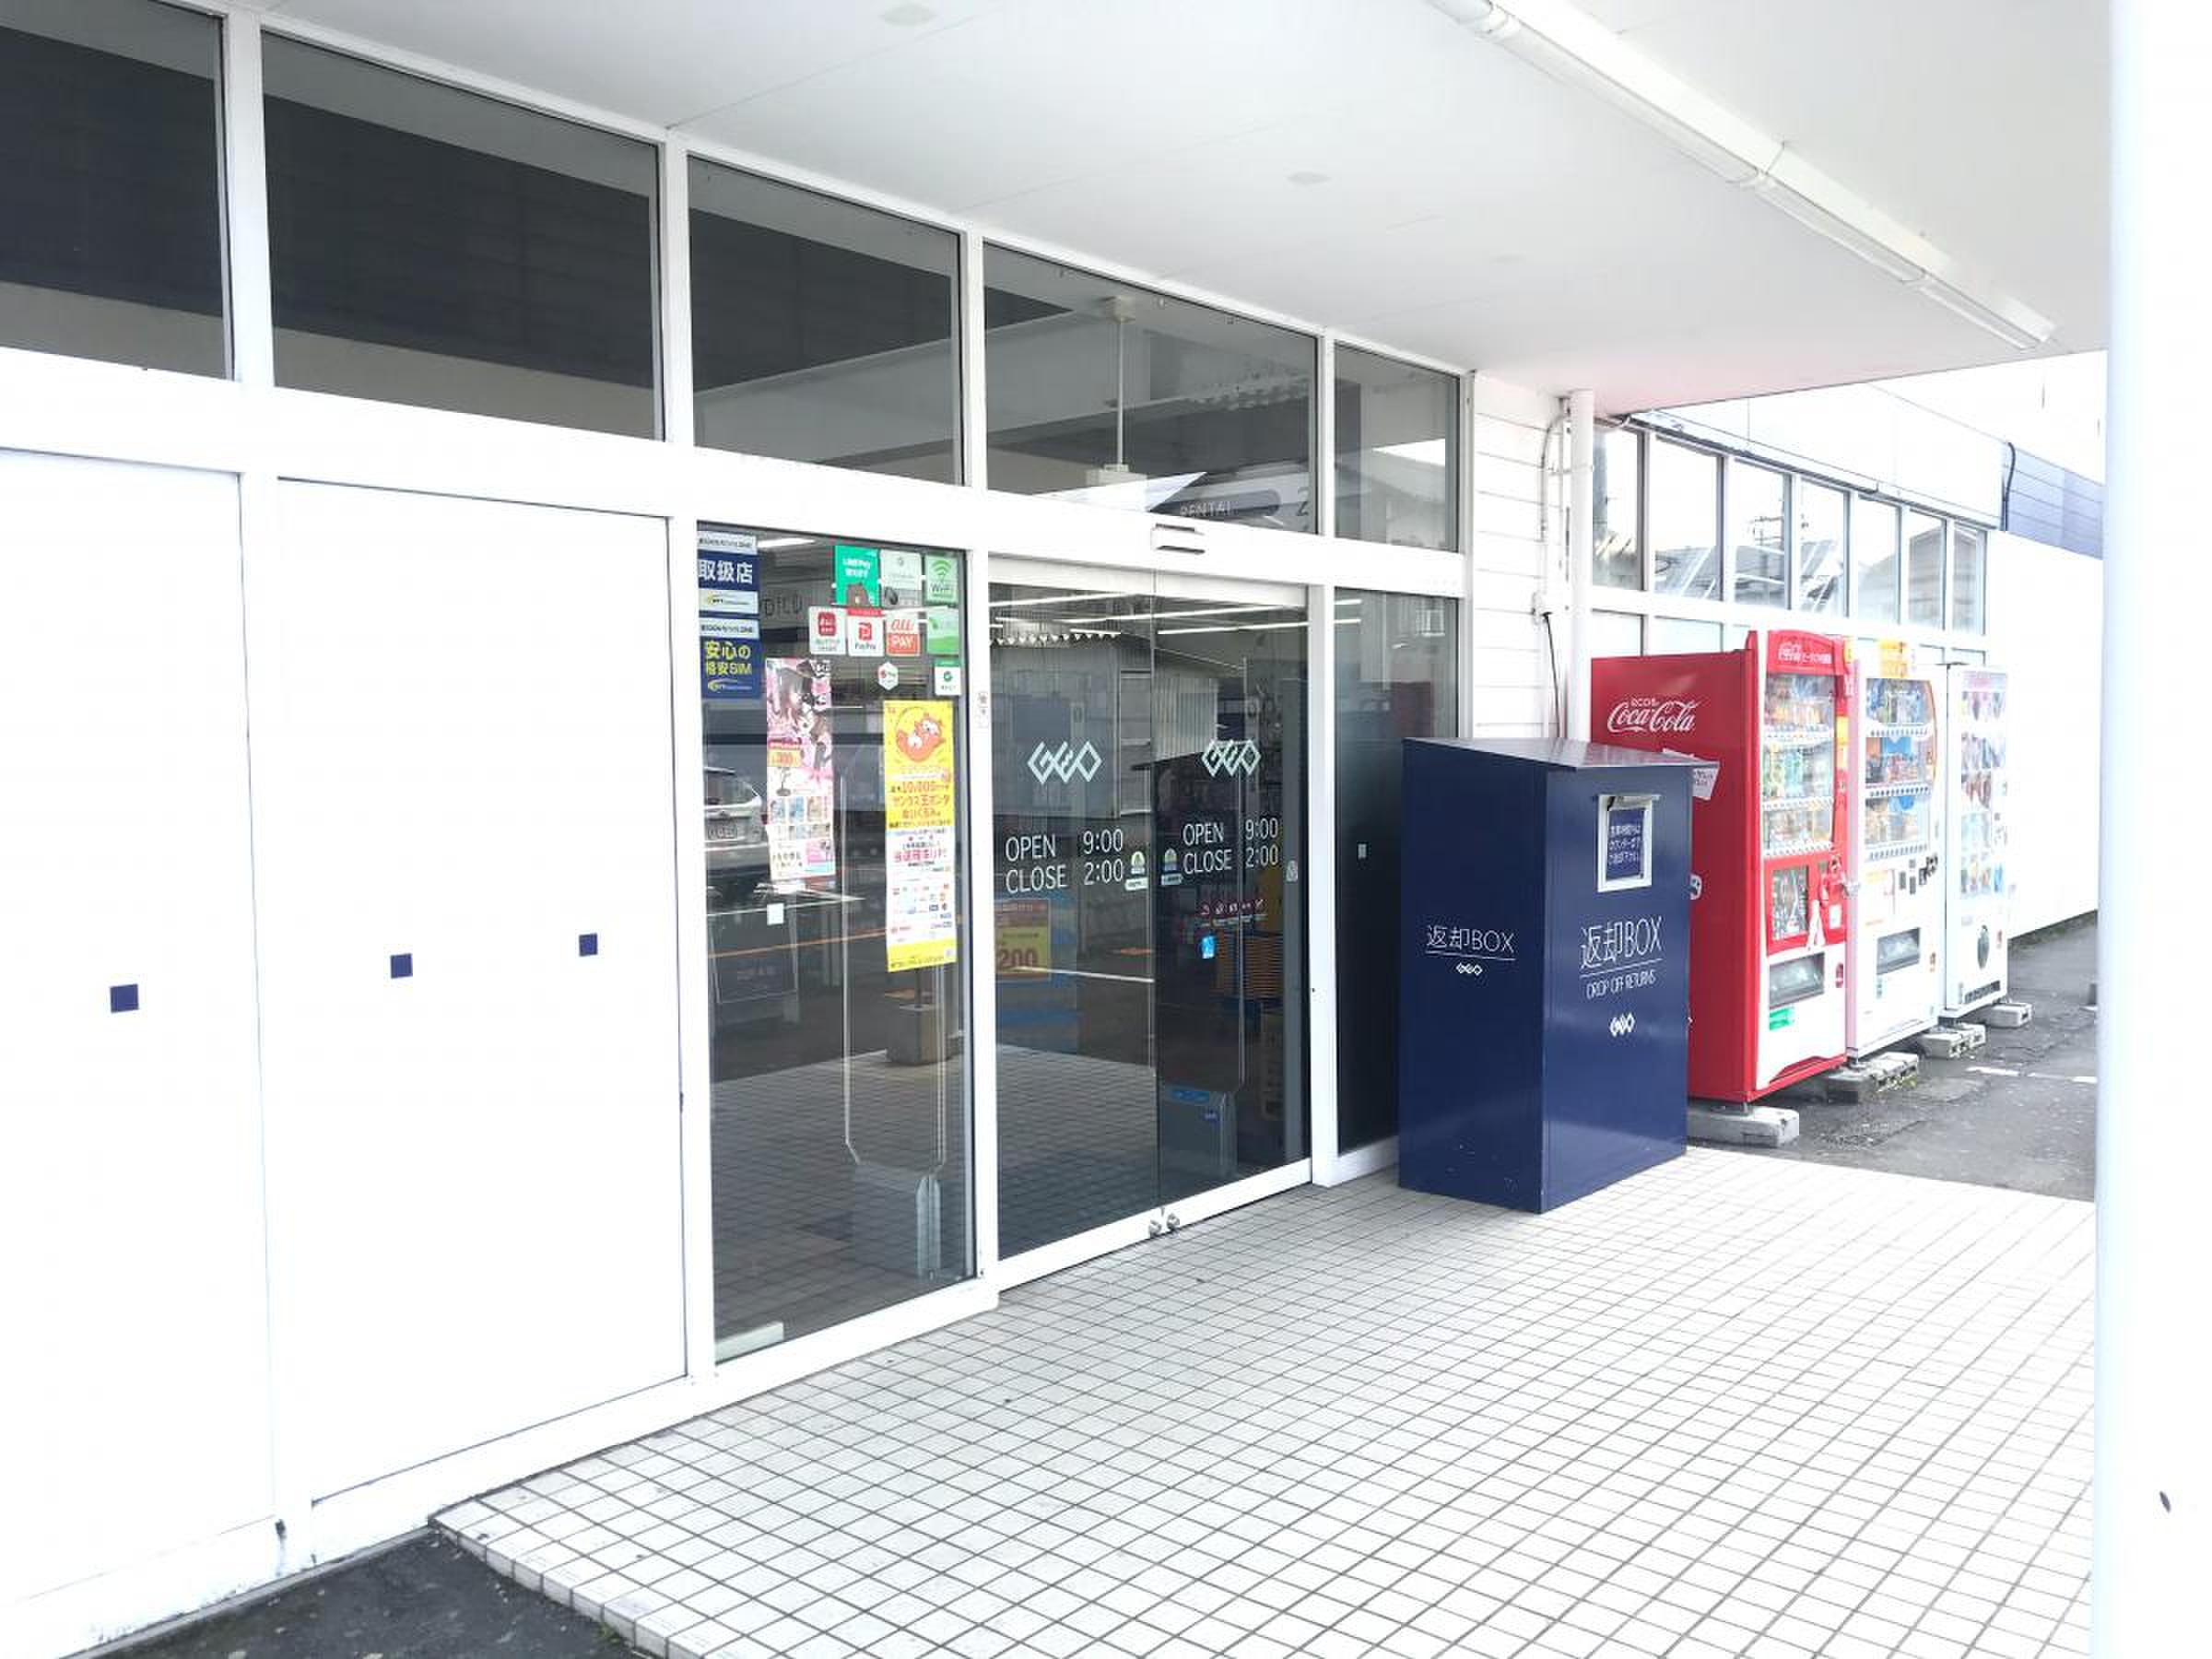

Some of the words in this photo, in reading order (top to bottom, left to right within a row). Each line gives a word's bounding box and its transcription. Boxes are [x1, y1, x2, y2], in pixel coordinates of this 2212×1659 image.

[699, 559, 753, 584] 取扱店
[704, 641, 751, 659] 安心の
[890, 634, 913, 649] PAY
[1606, 698, 1701, 734] Coca-Cola
[1028, 741, 1102, 784] GEO
[1202, 739, 1262, 778] GEO
[1006, 834, 1056, 862] OPEN
[1083, 830, 1124, 855] 9:00
[1183, 822, 1224, 846] OPEN
[1244, 818, 1279, 841] 9:00
[1183, 849, 1232, 875] CLOSE
[1245, 845, 1279, 868] 2:00
[1006, 865, 1067, 894] CLOSE
[1084, 859, 1124, 886] 2:00
[1426, 924, 1514, 953] 返却BOX
[1580, 916, 1663, 970] 返却BOX
[1586, 980, 1609, 999] DROP
[1610, 975, 1624, 994] OFF
[1625, 969, 1656, 989] RETURNS
